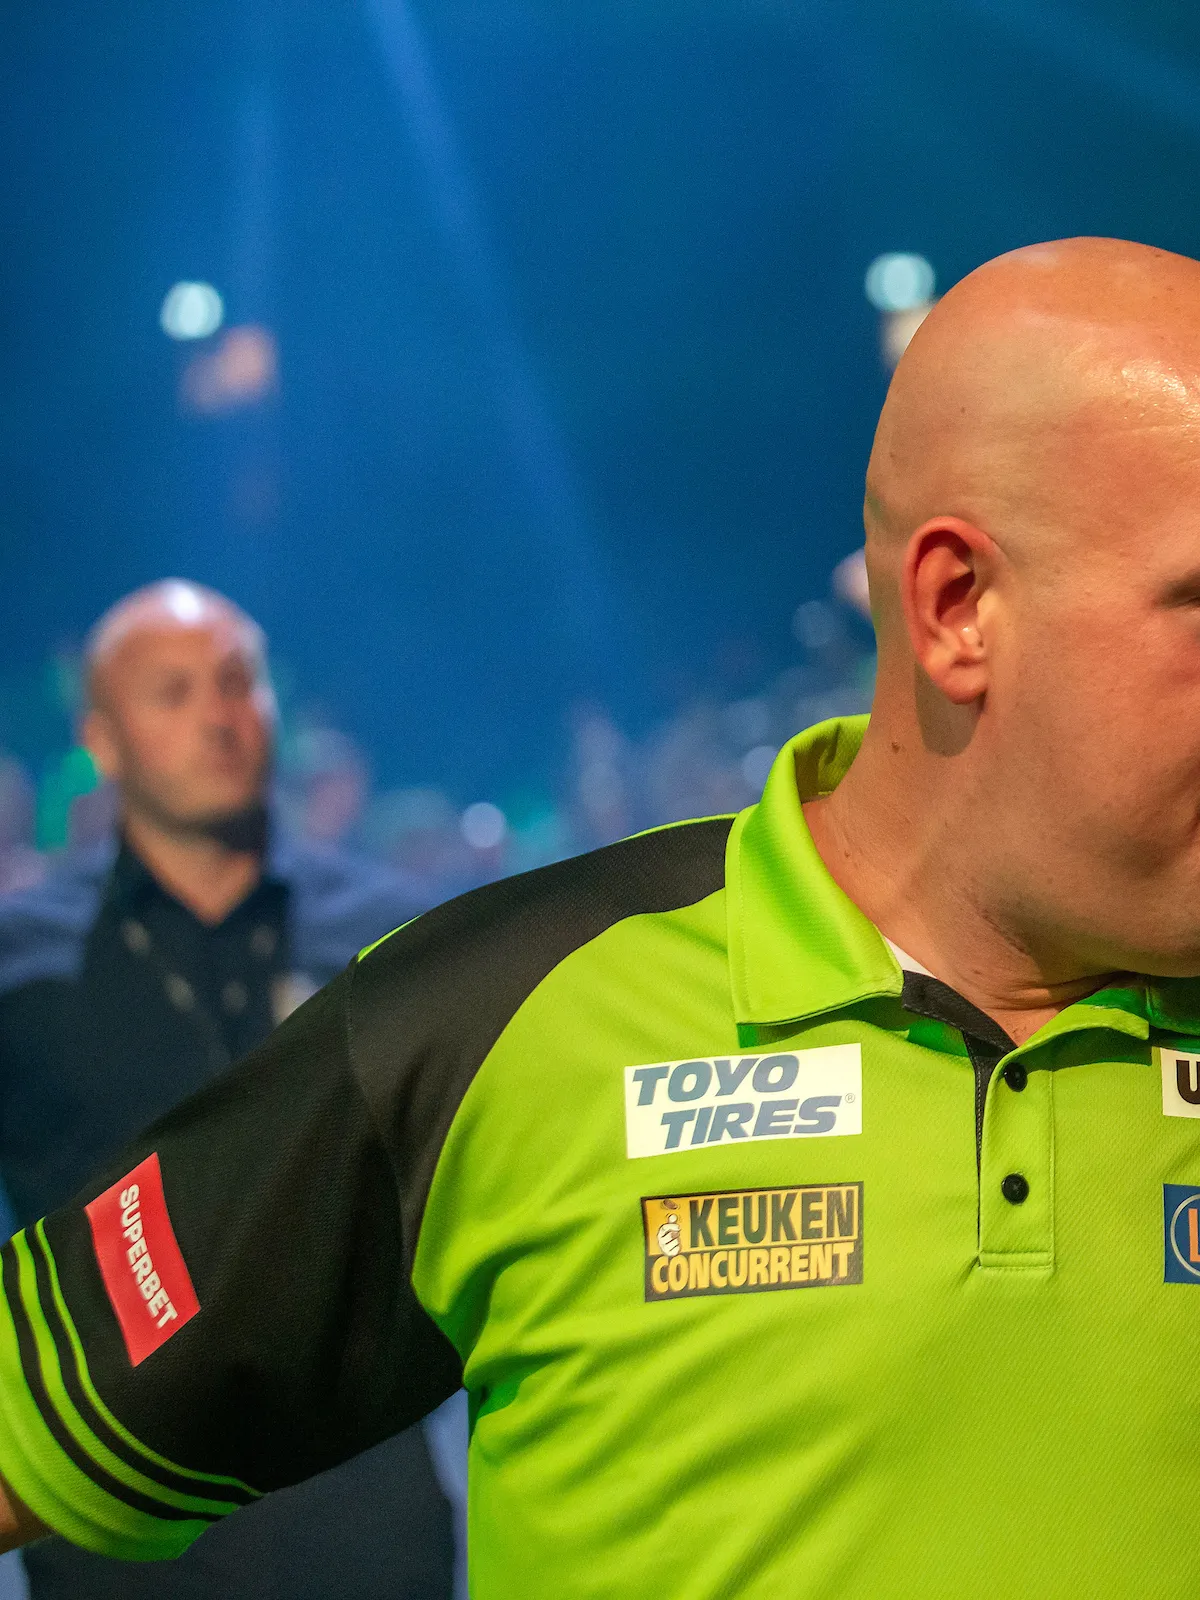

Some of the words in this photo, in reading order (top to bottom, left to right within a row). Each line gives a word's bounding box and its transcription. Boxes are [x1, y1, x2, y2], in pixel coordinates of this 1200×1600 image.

[633, 1055, 800, 1107] TOYO
[689, 1189, 854, 1248] KEUKEN
[119, 1184, 178, 1329] SUPERBET
[652, 1242, 854, 1293] CONCURRENT
